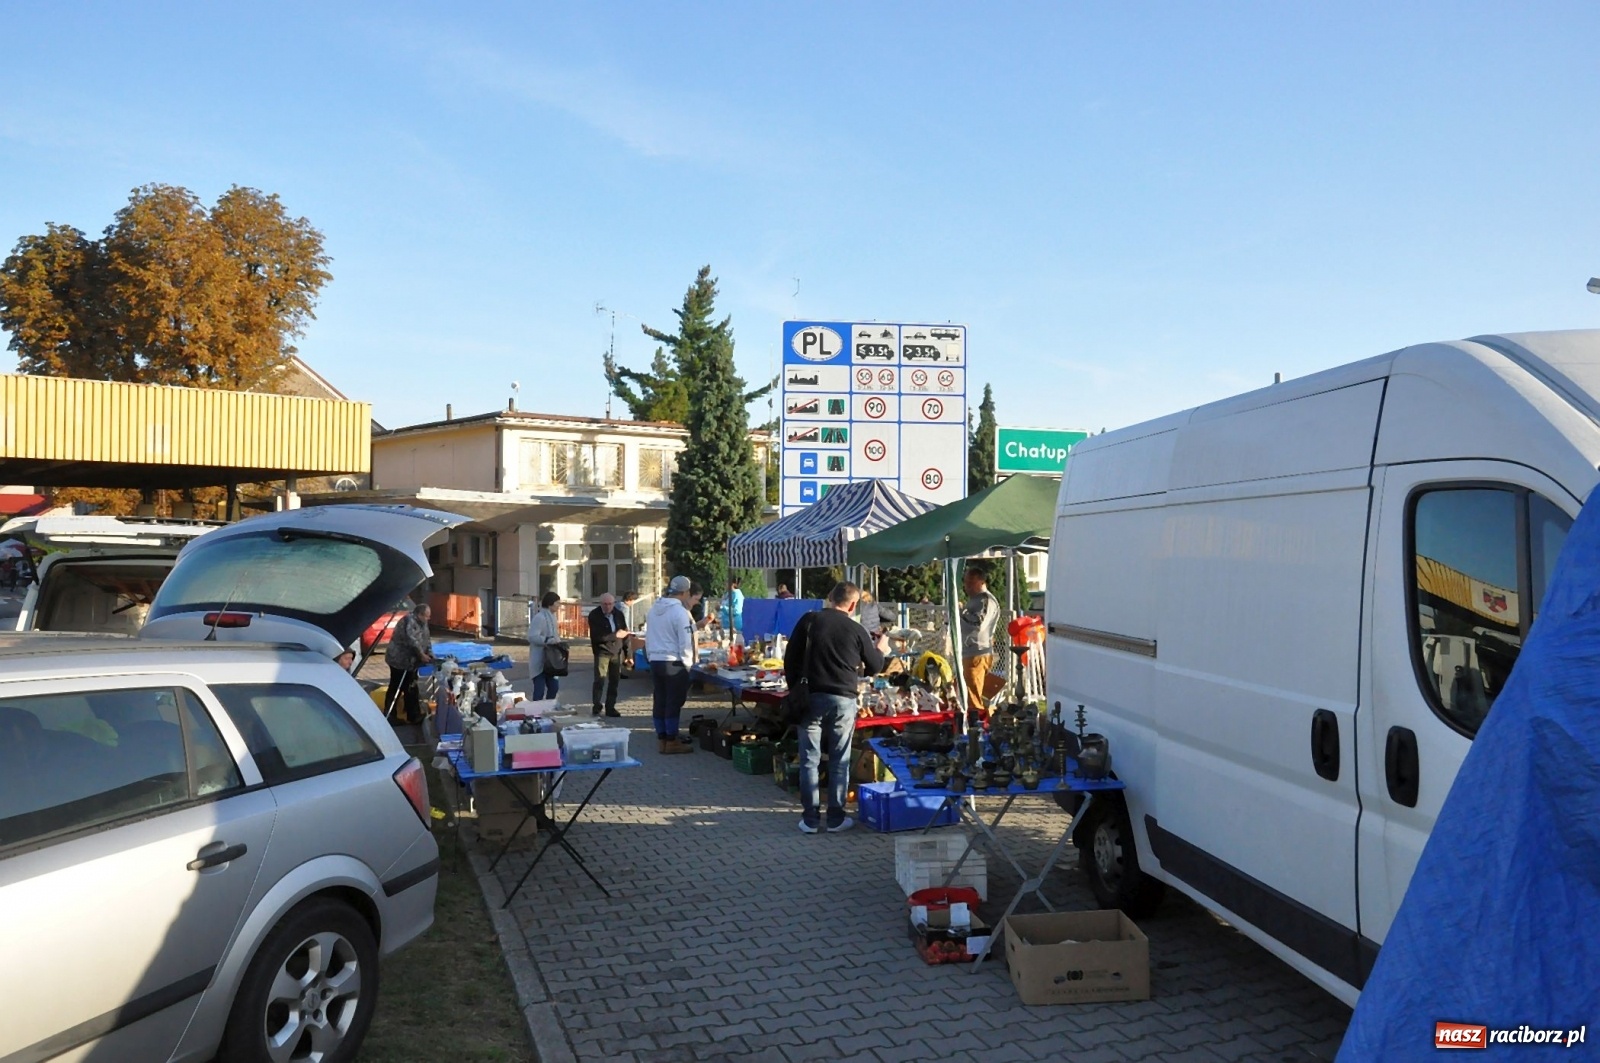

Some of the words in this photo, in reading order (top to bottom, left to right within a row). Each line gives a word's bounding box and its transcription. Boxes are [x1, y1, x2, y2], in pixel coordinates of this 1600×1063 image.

[803, 332, 832, 355] PL
[859, 373, 870, 381] 50
[881, 373, 892, 381] 60
[914, 374, 925, 382] 50
[868, 402, 883, 413] 90
[927, 403, 940, 414] 70
[868, 446, 883, 455] 100
[925, 473, 940, 484] 80
